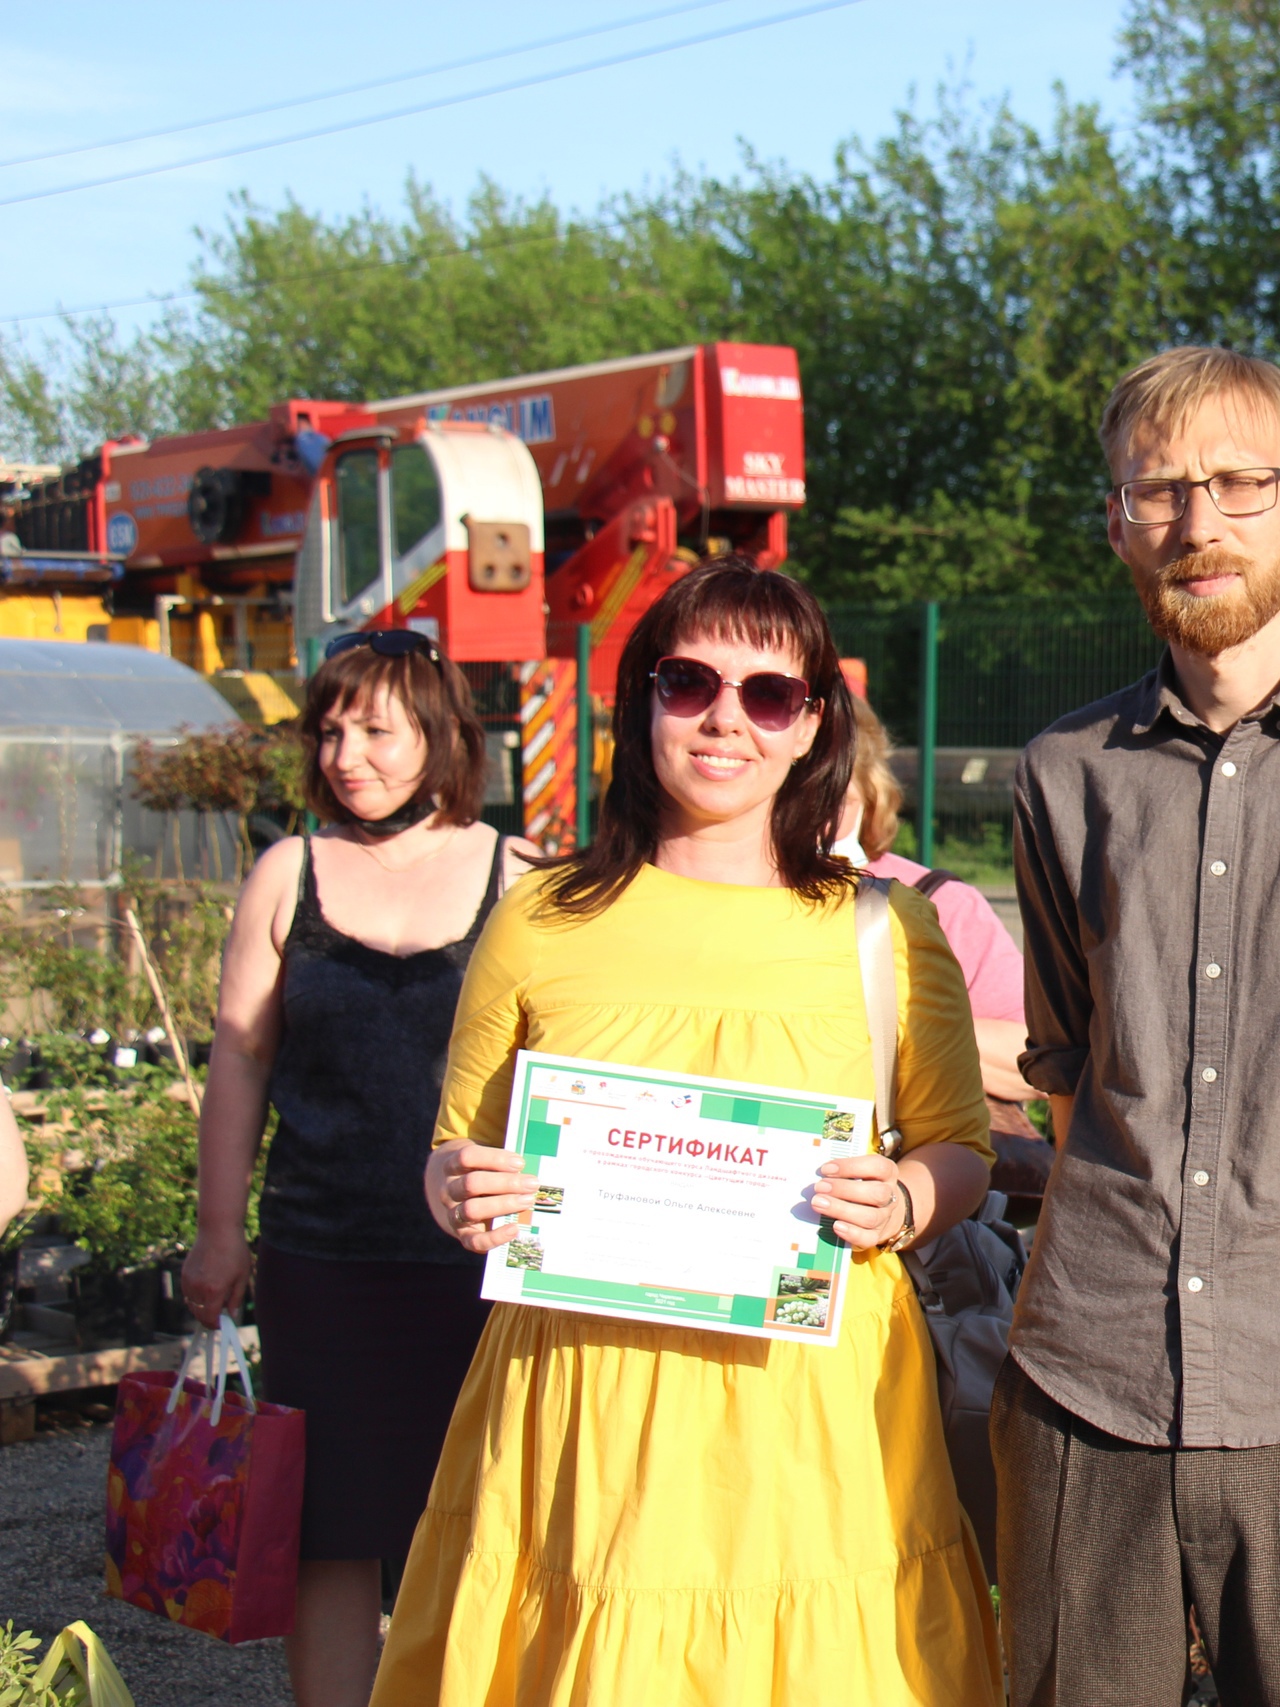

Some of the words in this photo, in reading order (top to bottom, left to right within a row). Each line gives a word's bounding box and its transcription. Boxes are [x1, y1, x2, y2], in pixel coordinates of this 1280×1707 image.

[743, 452, 785, 476] SKY
[725, 476, 806, 503] MASTER
[607, 1128, 769, 1166] СЕРТИФИКАТ
[663, 1198, 694, 1210] Ольге
[696, 1203, 756, 1219] Алексеевне
